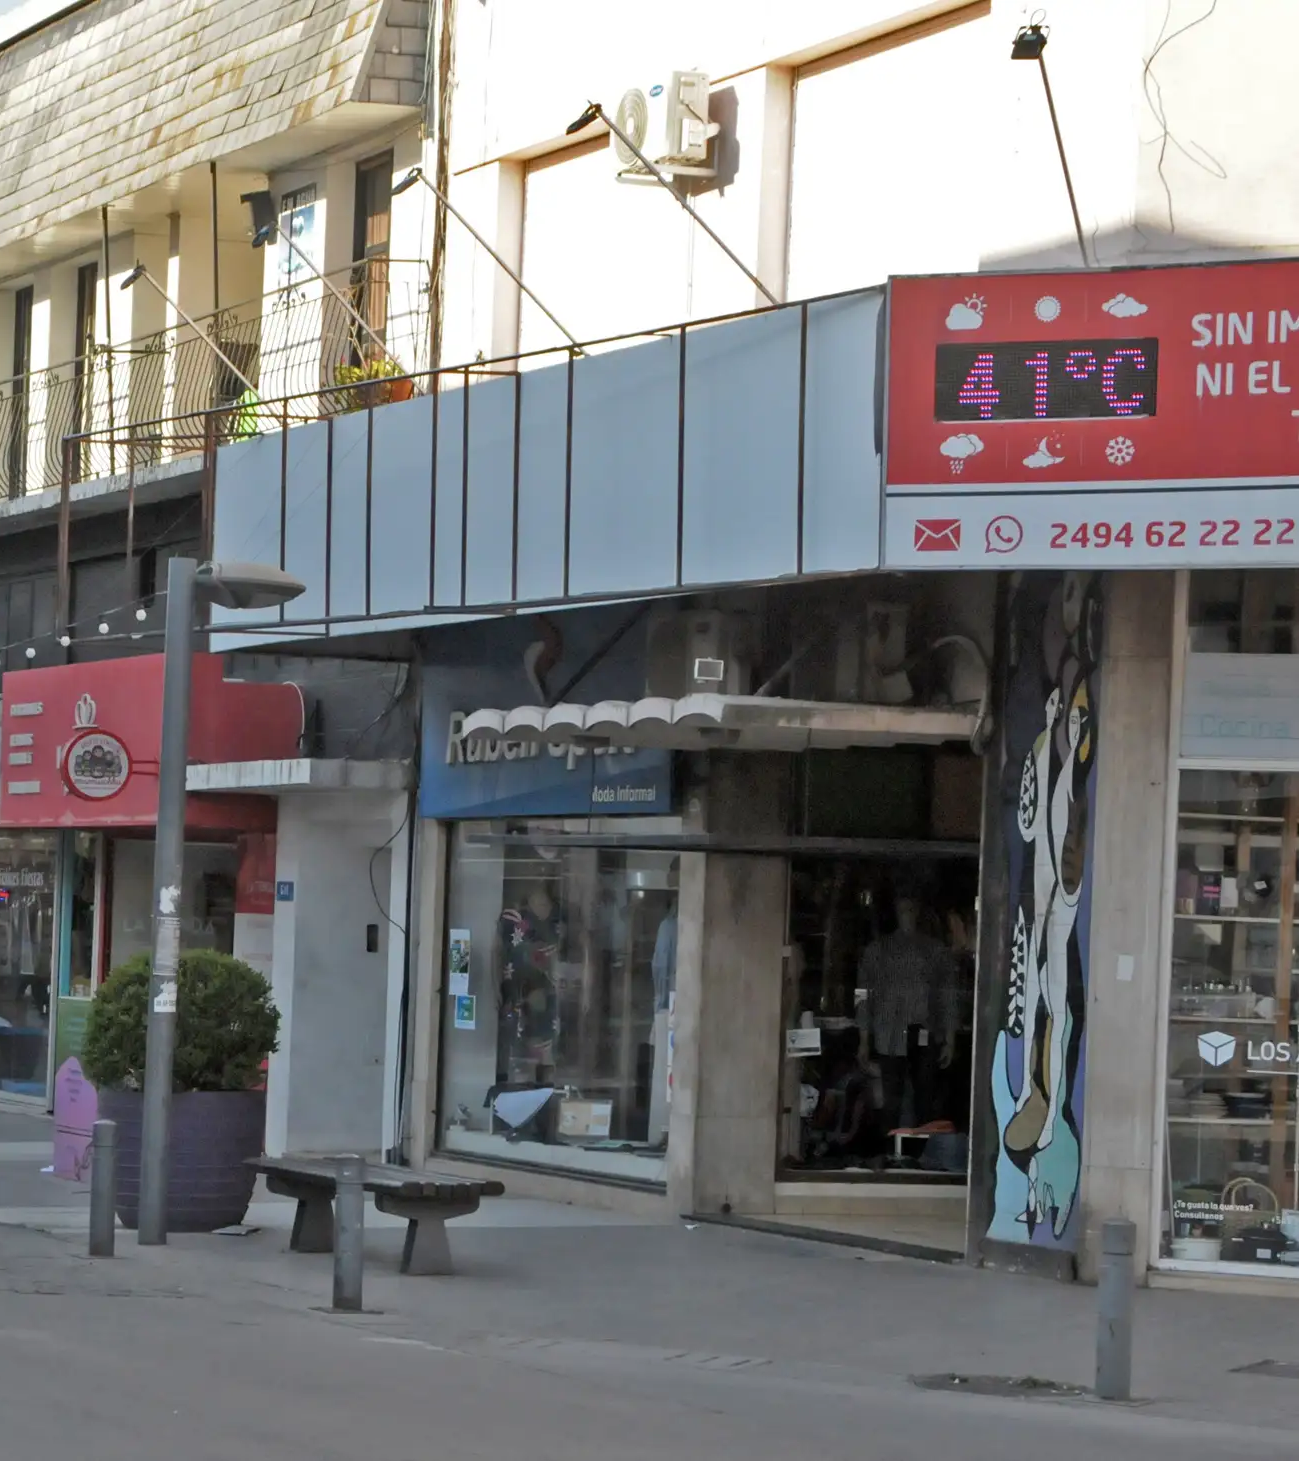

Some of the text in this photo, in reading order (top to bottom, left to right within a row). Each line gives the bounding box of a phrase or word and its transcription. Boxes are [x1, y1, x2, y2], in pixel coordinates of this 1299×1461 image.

[1191, 311, 1254, 348] SIN
[1196, 359, 1291, 397] NI EL
[1049, 518, 1296, 549] 2494 62 22 22
[616, 783, 656, 802] Informal
[1247, 1040, 1291, 1062] LOS
